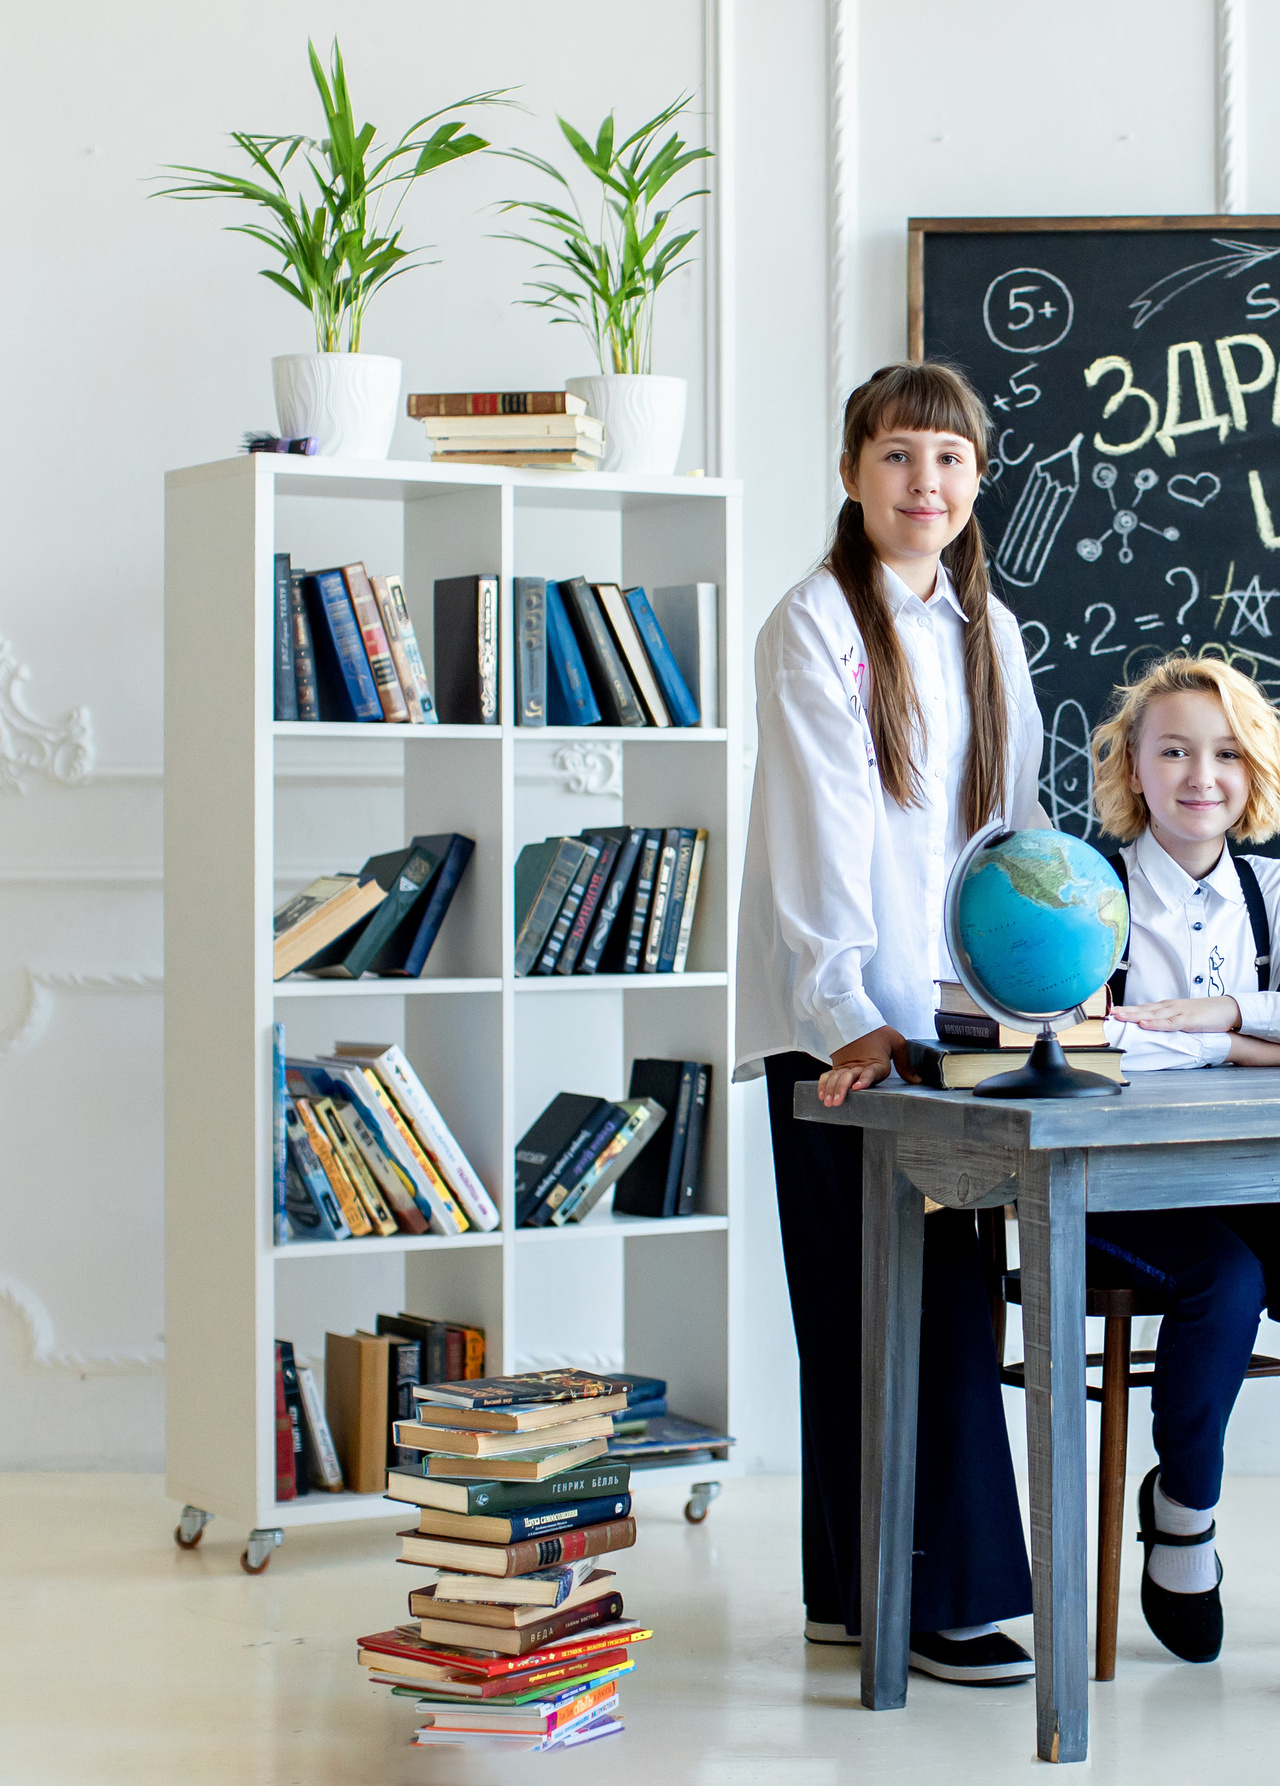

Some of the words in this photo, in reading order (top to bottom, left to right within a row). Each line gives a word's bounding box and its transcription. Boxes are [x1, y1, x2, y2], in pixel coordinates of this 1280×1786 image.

[1007, 285, 1058, 331] 5+
[551, 1479, 586, 1494] ГЕНРИХ
[591, 1474, 620, 1488] БЁЛЛЬ
[523, 1514, 540, 1532] Наука
[530, 1626, 555, 1644] ВЕДА
